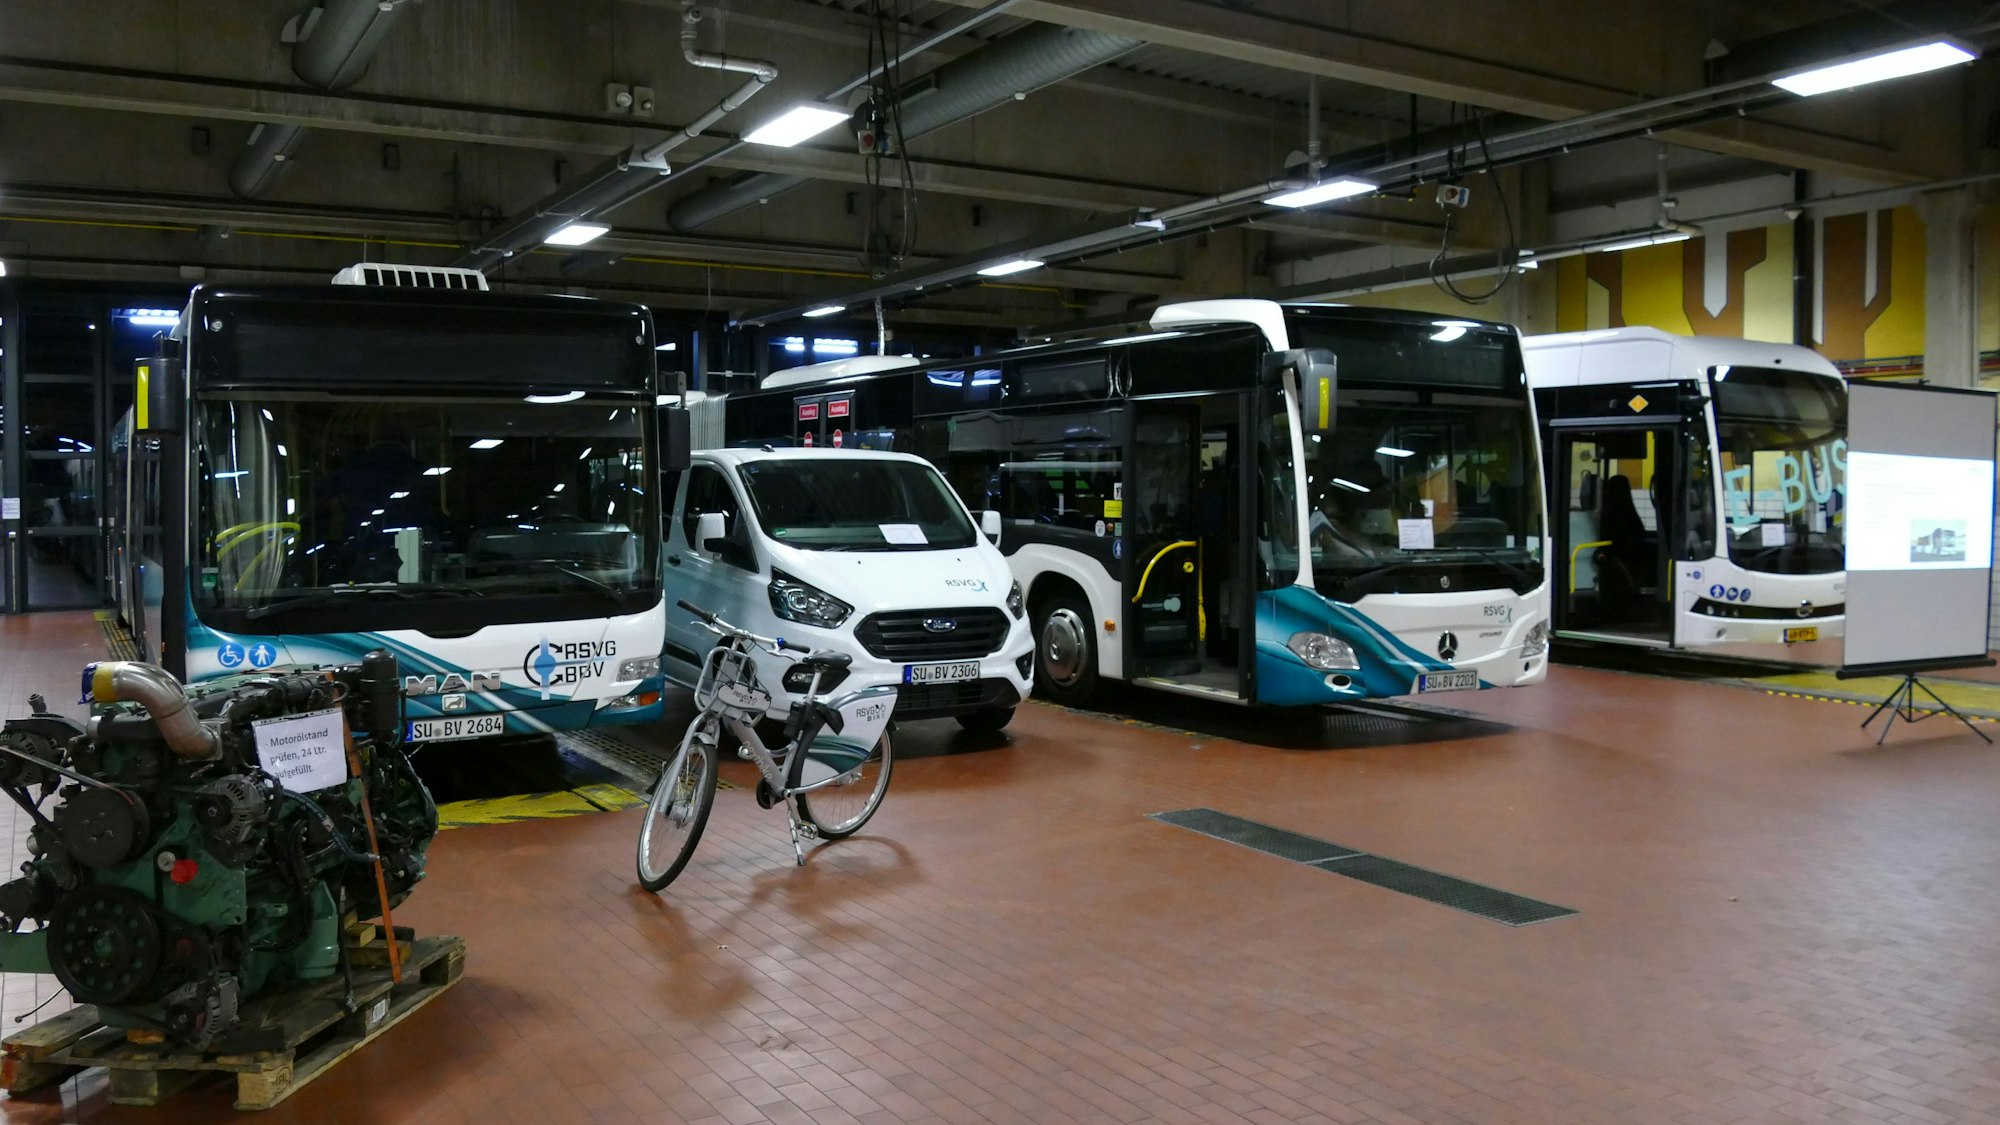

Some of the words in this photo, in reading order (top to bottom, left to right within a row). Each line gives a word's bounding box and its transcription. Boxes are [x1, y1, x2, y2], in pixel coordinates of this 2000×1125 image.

[945, 579, 976, 587] RSVG
[1483, 605, 1505, 616] RSVG
[565, 640, 616, 660] RSVG
[565, 661, 605, 683] BBV
[912, 667, 927, 680] SU
[935, 666, 950, 679] BV
[951, 664, 977, 678] 2306
[405, 671, 501, 696] MAN
[1426, 677, 1438, 689] SU
[1443, 675, 1454, 688] BV
[413, 721, 433, 739] SU
[444, 719, 463, 735] BV
[467, 716, 502, 734] 2684
[270, 728, 328, 747] Motorölstand
[270, 751, 300, 765] prüfen,
[301, 747, 312, 758] 24
